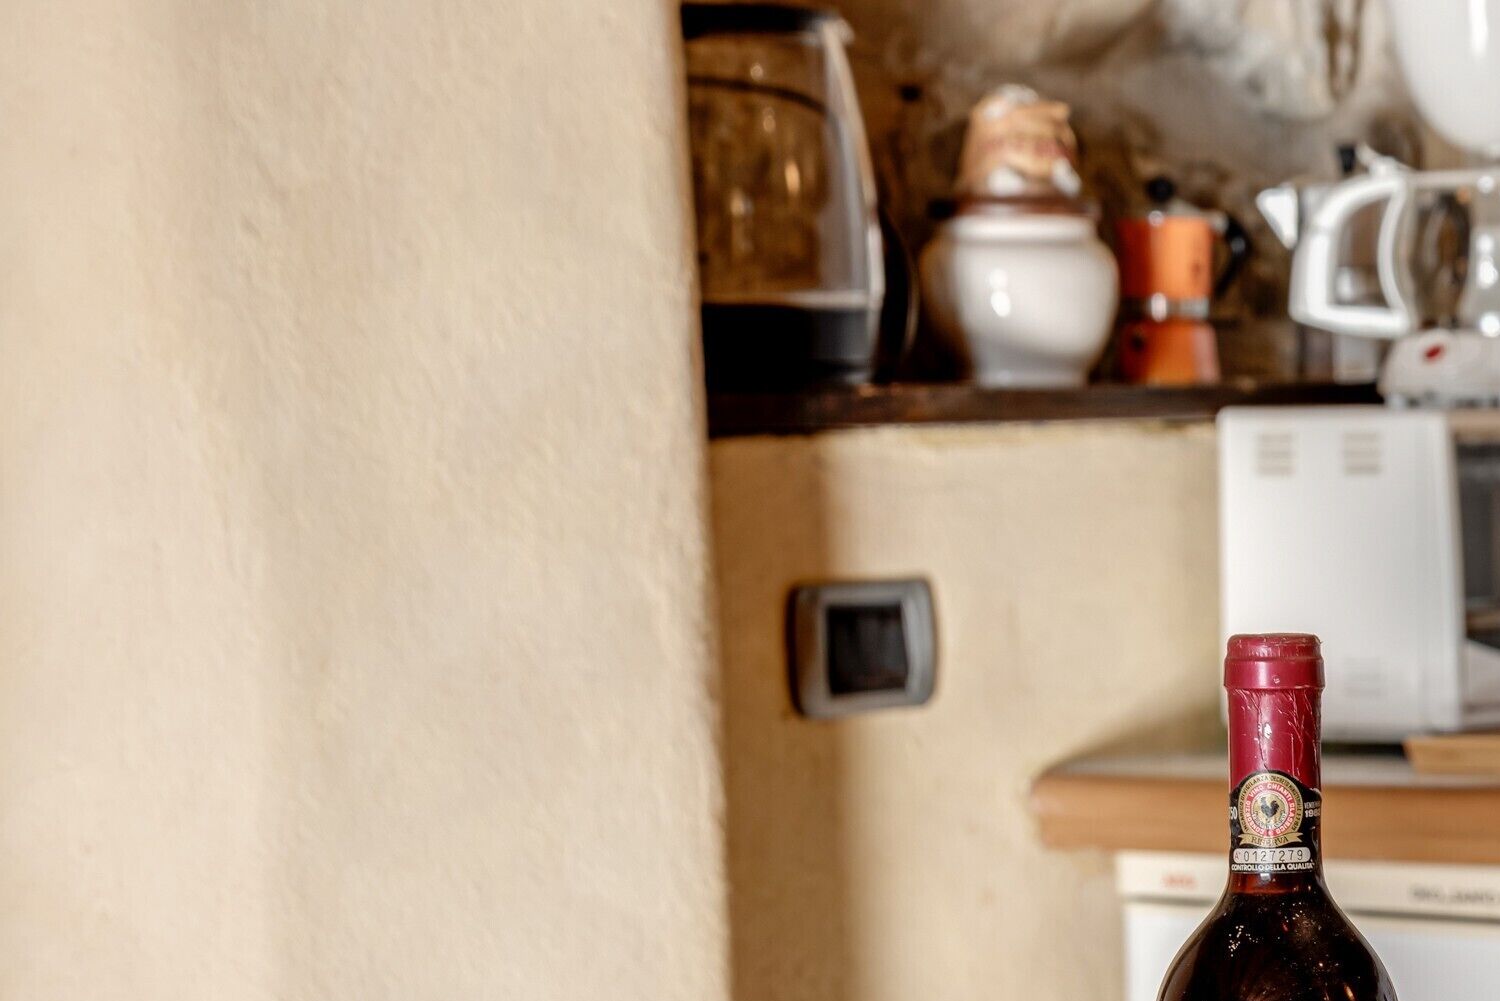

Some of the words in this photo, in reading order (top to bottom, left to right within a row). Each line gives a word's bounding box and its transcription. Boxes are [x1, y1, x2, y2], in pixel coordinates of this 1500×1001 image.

[1267, 783, 1292, 801] CHIANTI
[1243, 849, 1303, 862] 0127279
[1264, 863, 1286, 871] DELLA
